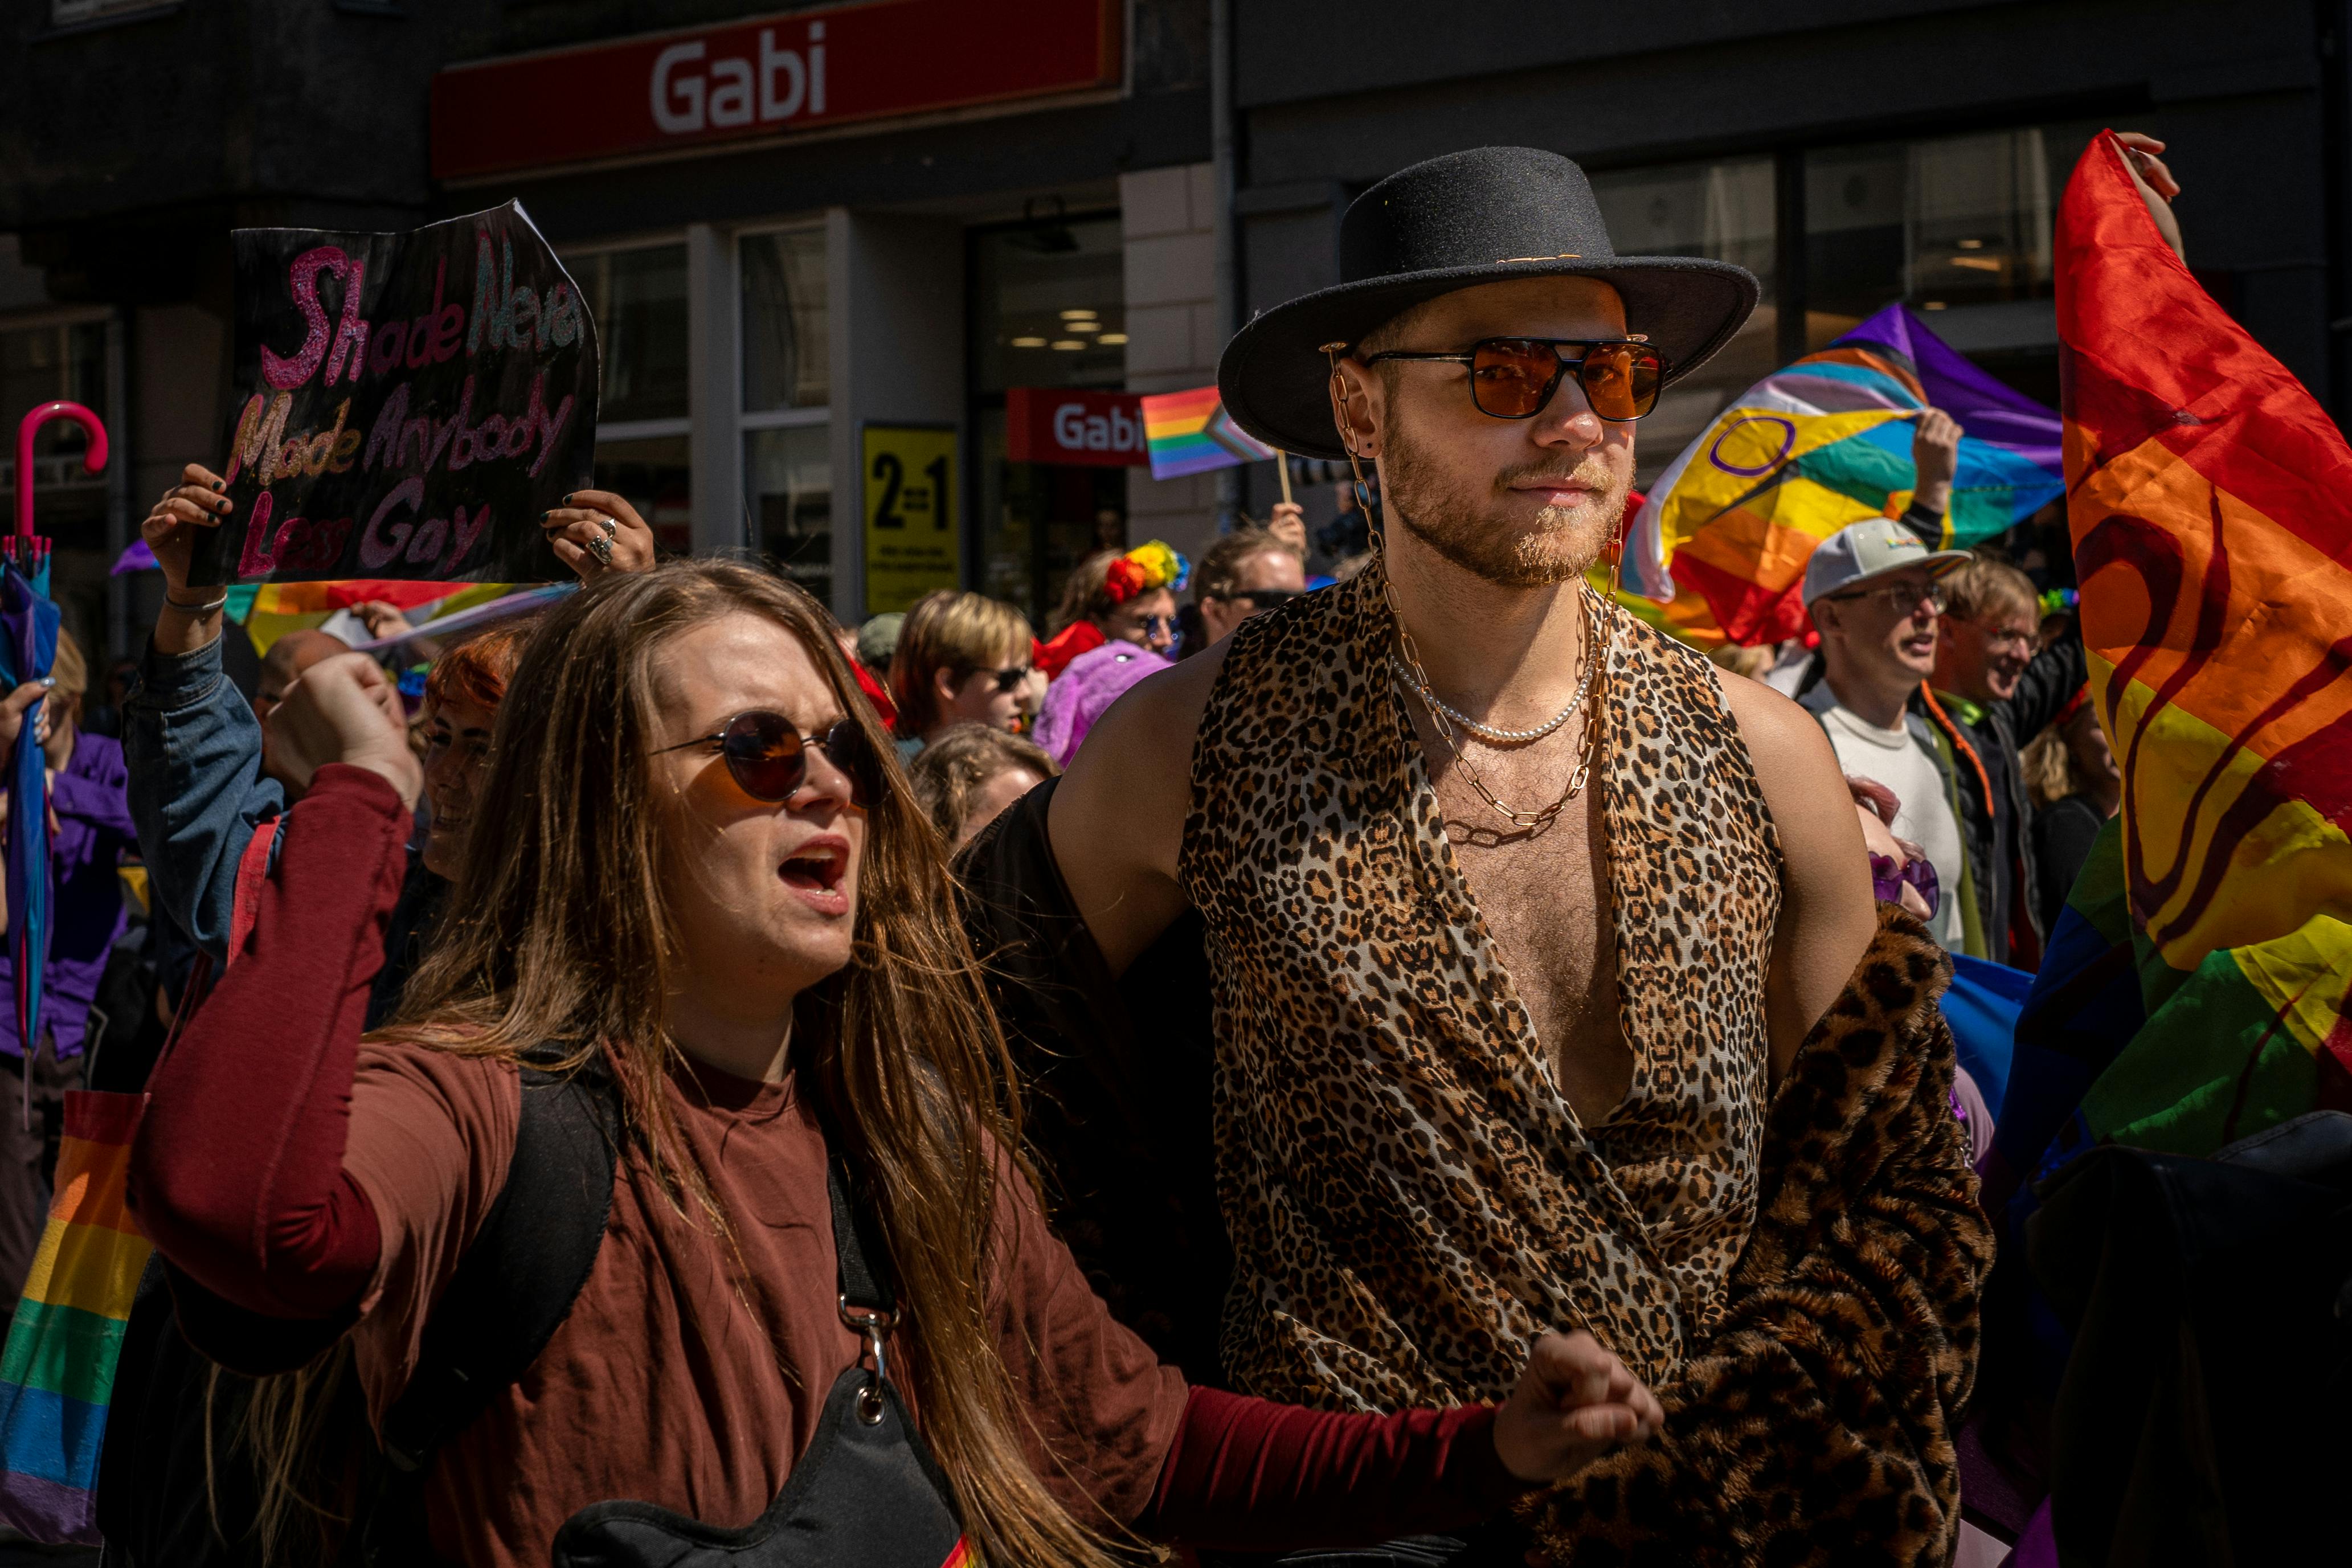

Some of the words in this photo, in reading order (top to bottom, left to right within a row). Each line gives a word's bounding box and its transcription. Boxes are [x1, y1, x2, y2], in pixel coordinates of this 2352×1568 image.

[650, 21, 827, 134] Gabi
[261, 246, 464, 390] Shade
[226, 392, 362, 486] Made
[363, 374, 575, 478] Anybody
[1053, 402, 1147, 452] Gabi
[238, 491, 353, 578] Less
[360, 477, 490, 574] Gay
